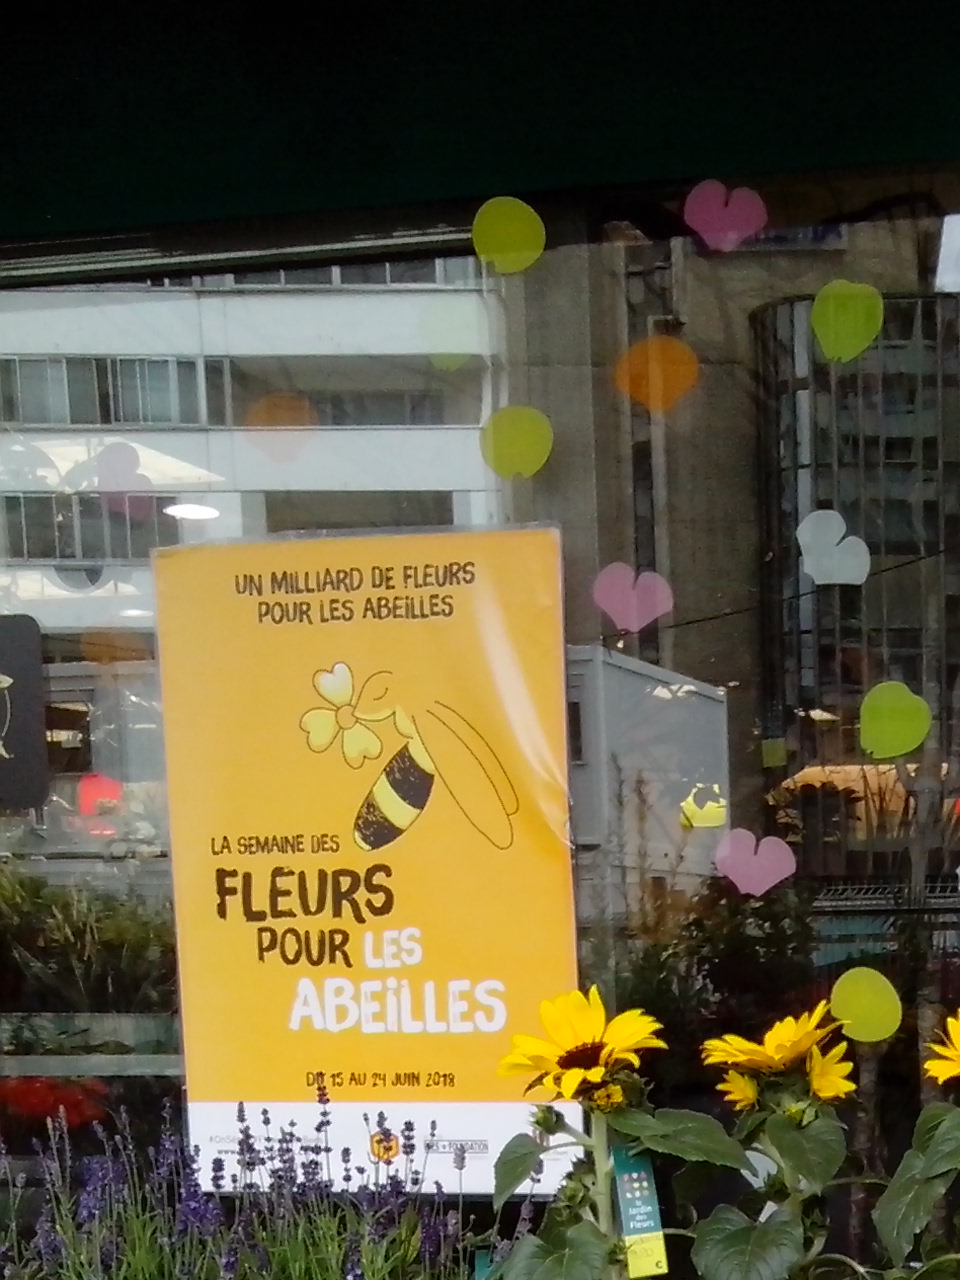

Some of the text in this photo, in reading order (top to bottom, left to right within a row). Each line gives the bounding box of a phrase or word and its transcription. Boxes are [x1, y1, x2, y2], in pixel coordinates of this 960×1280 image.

[235, 561, 477, 596] UN MILLIARD DE FLEURS
[257, 599, 313, 625] POUR
[319, 597, 354, 622] LES
[210, 833, 340, 856] LA SEMAINE DES
[215, 863, 395, 924] FLEURS
[256, 926, 423, 969] POUR LES
[330, 1071, 344, 1087] 15
[349, 1071, 366, 1087] AU
[372, 1072, 387, 1088] 24
[391, 1071, 421, 1087] JUIN
[425, 1071, 456, 1088] 2018
